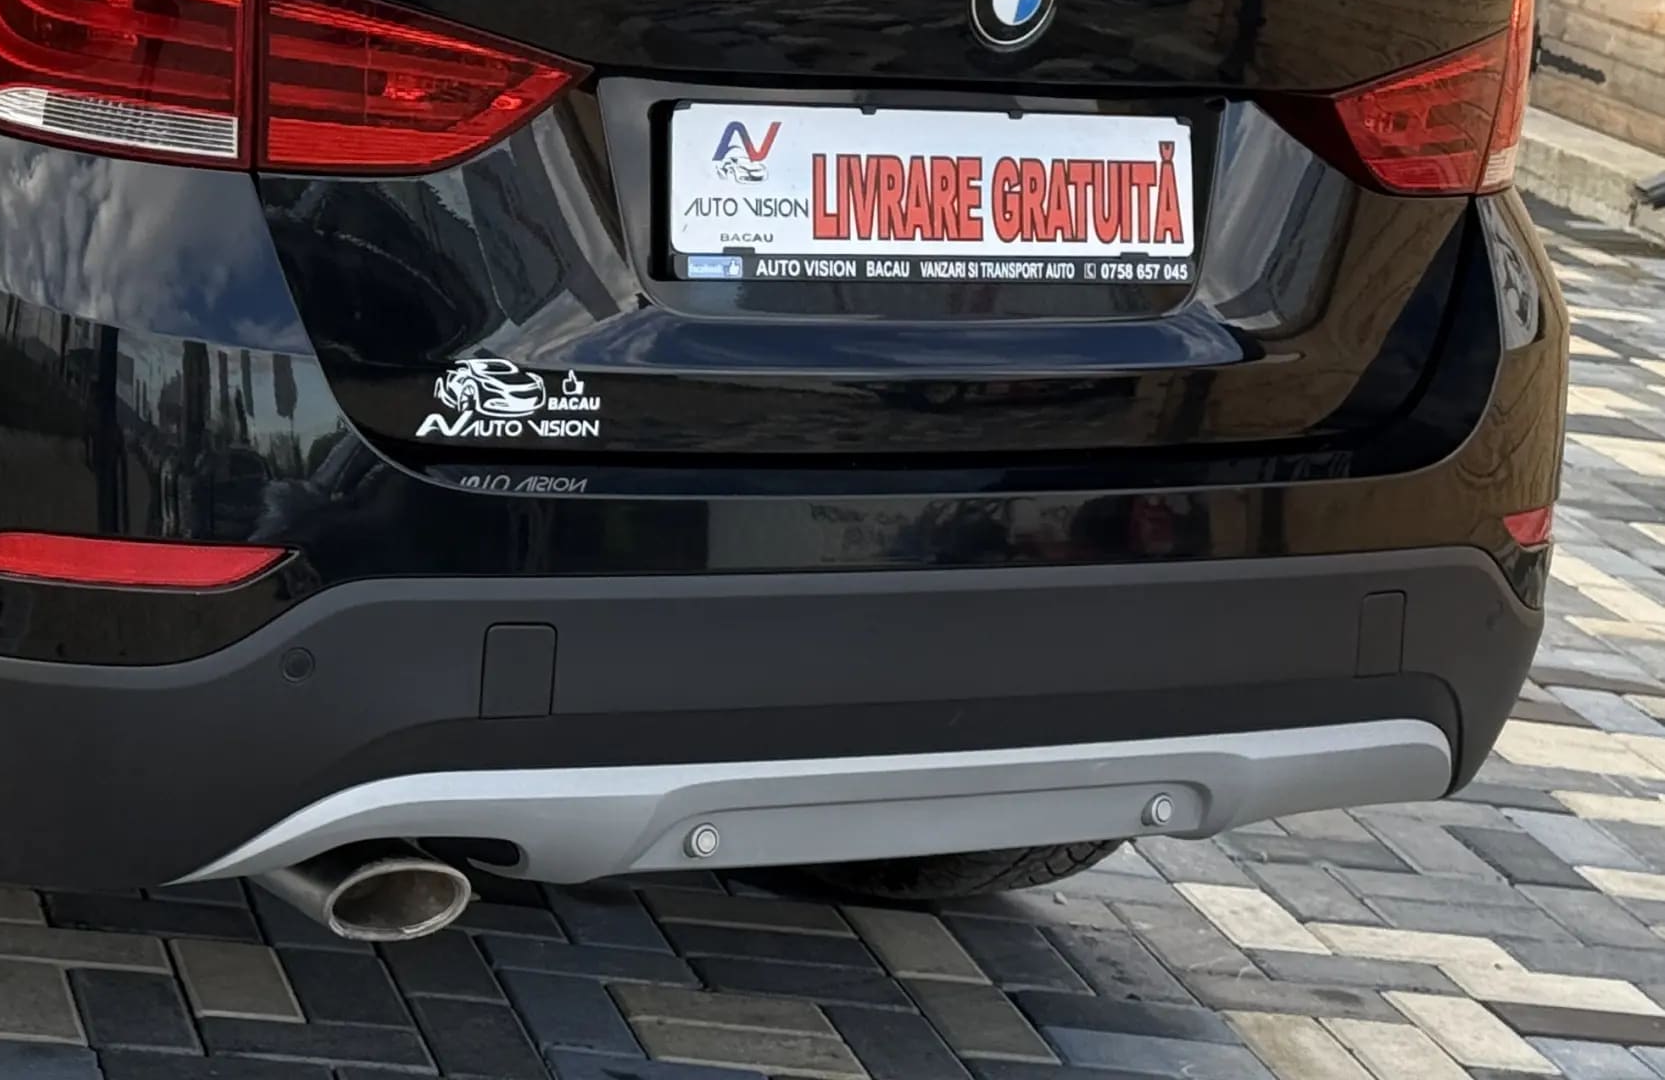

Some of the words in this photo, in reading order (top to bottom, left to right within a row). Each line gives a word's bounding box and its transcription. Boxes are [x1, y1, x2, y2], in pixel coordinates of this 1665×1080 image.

[812, 153, 983, 241] LIVRARE
[991, 141, 1184, 244] GRATUITĂ
[684, 197, 738, 217] AUTO
[742, 197, 809, 218] VISION
[720, 233, 774, 243] BACAU
[756, 260, 800, 276] AUTO
[804, 260, 856, 277] VISION
[866, 261, 910, 277] BACAU
[920, 261, 965, 278] VANZARI
[968, 262, 978, 278] SI
[980, 262, 1044, 279] TRANSPORT
[1046, 263, 1075, 279] AUTO
[1101, 264, 1133, 280] 0758
[1137, 264, 1160, 280] 657
[1163, 264, 1188, 281] 045
[548, 397, 601, 410] BACAU
[459, 420, 523, 437] AUTO
[528, 420, 600, 437] VISION
